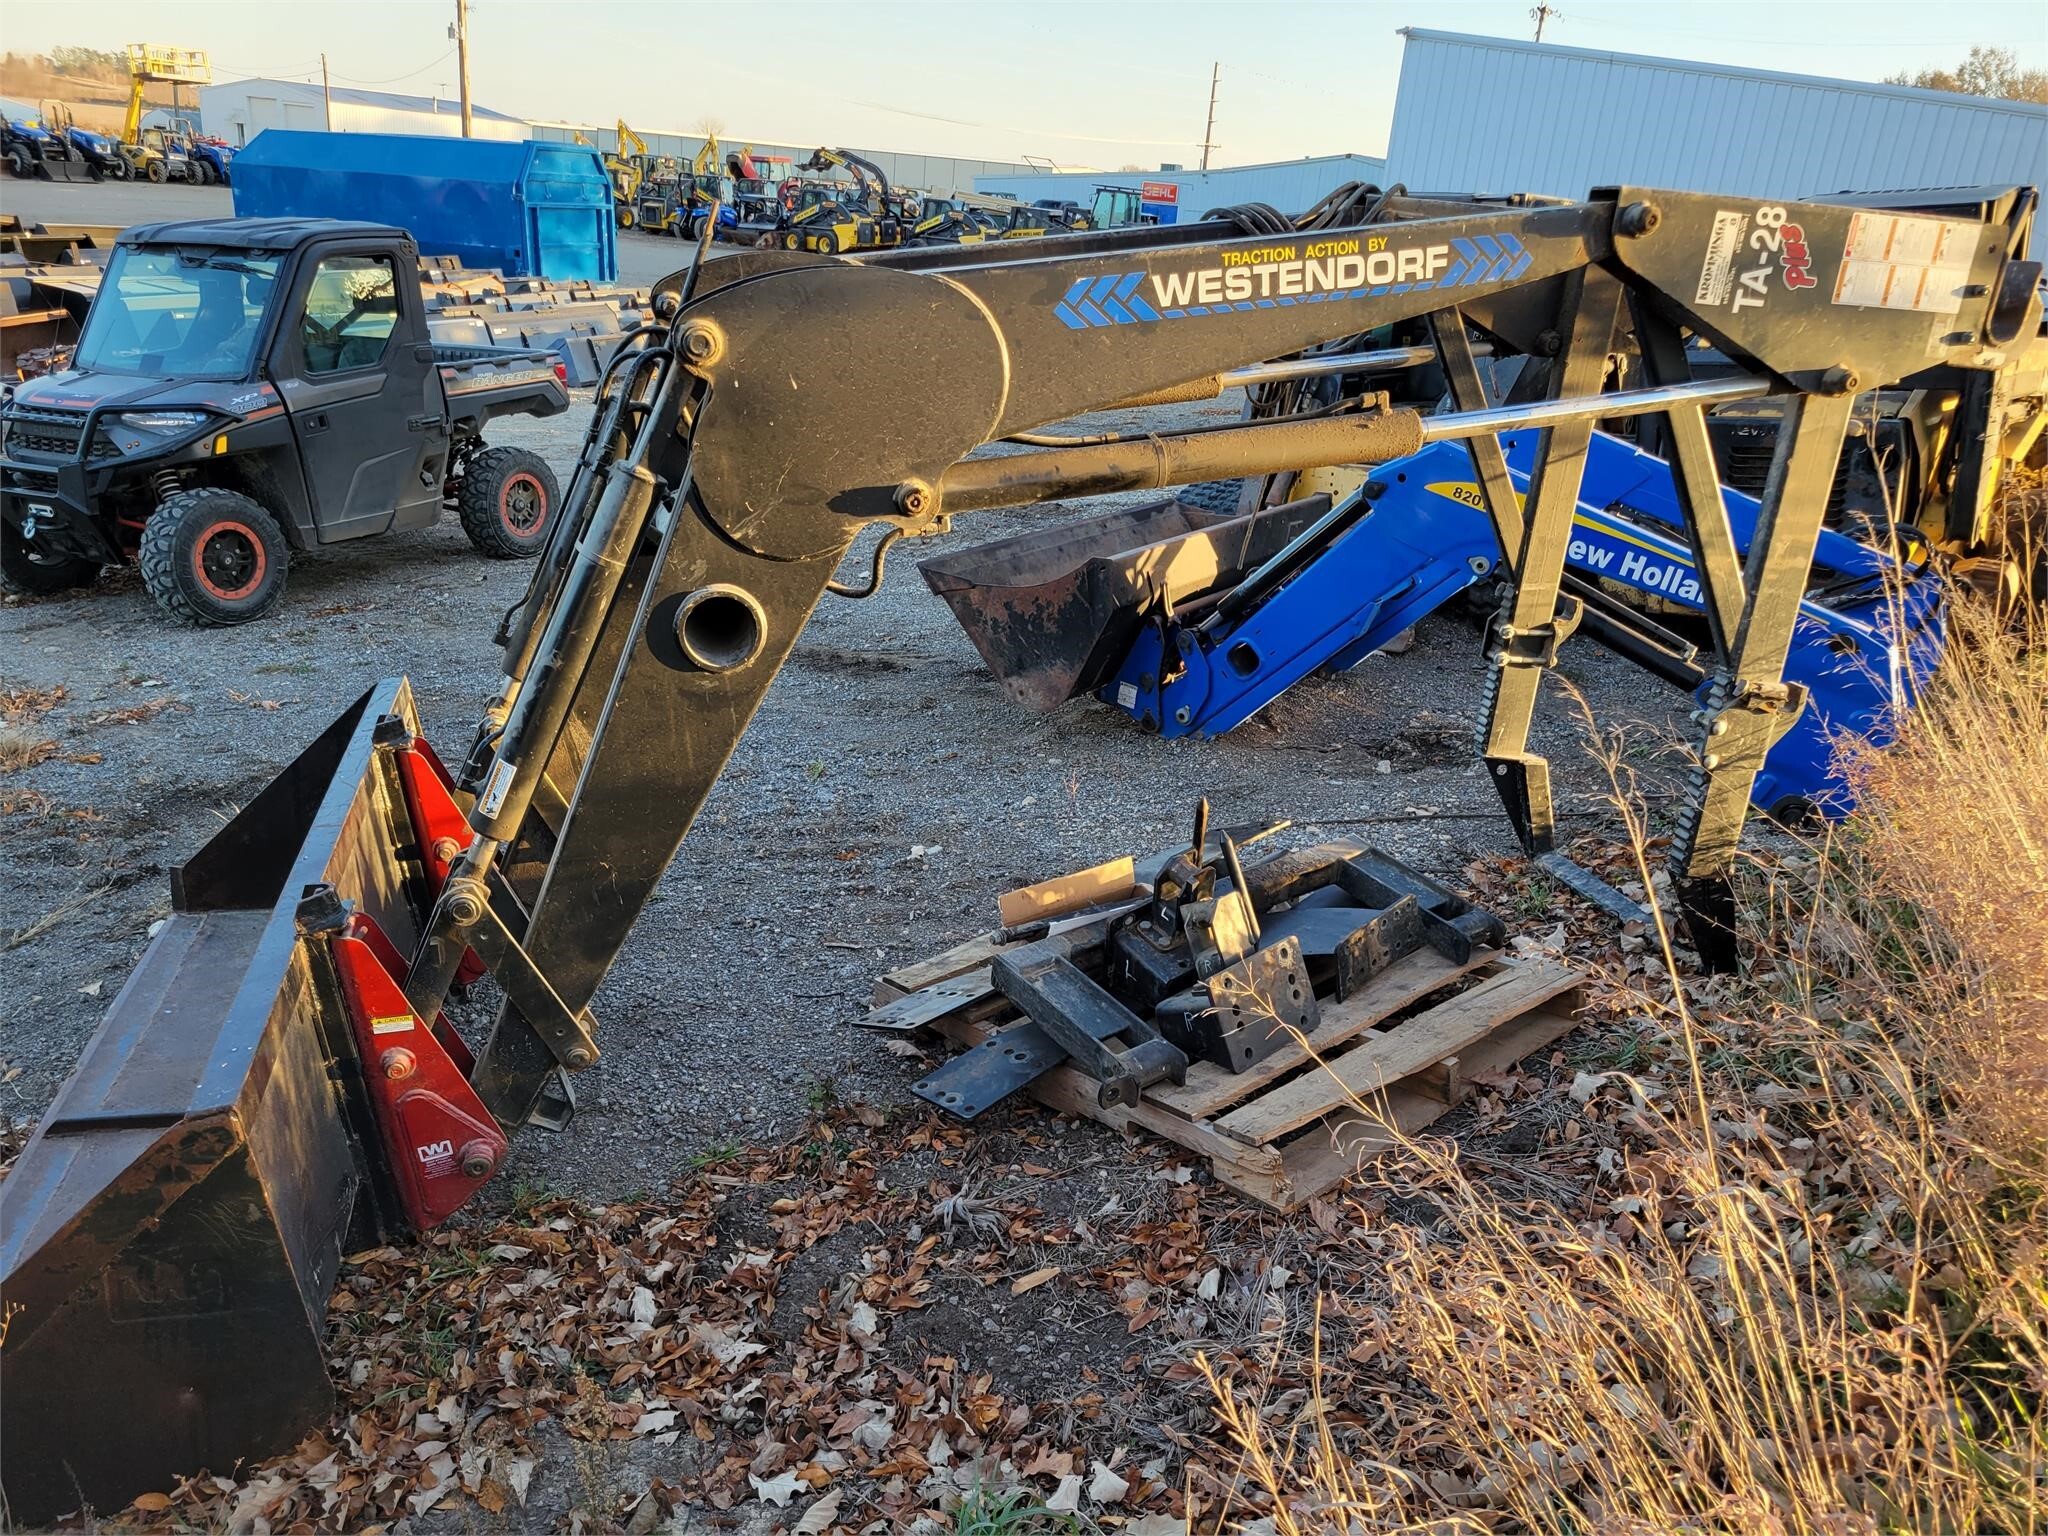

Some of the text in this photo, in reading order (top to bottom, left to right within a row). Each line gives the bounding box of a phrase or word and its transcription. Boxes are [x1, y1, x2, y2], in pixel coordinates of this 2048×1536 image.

[1143, 186, 1175, 199] GEHL
[1221, 236, 1388, 267] TRACTION ACTION BY
[1731, 206, 1788, 314] TA-28
[1151, 244, 1449, 308] WESTENDORF
[231, 392, 258, 405] XP
[1453, 486, 1486, 509] 820
[1568, 531, 1614, 569] ew
